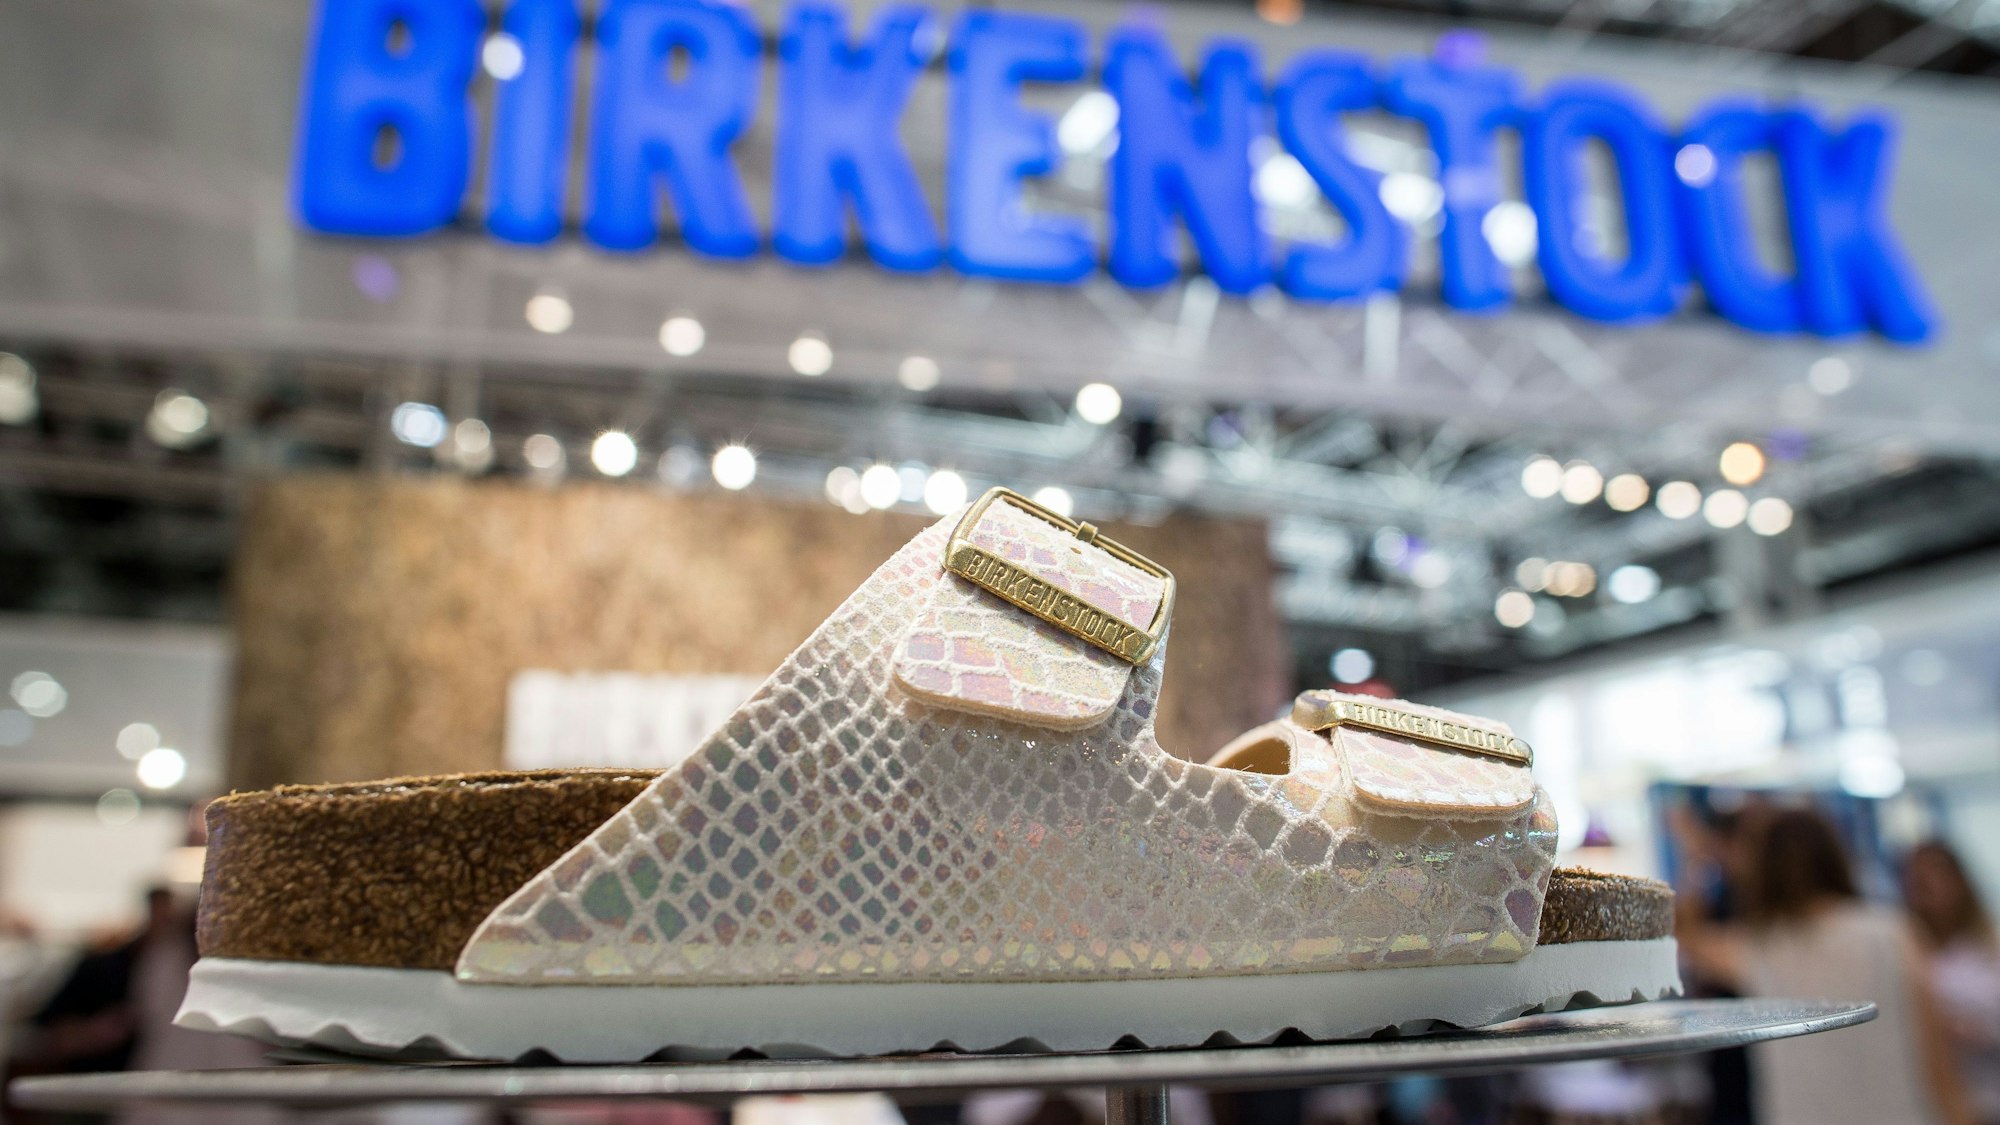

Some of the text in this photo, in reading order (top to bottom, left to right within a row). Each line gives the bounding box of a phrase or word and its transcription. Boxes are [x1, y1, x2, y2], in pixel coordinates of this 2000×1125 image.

[294, 0, 1938, 343] BIRKENSTOCK
[964, 550, 1135, 655] BIRKENSTOCK
[1354, 703, 1519, 755] BIRKENSTOCK
